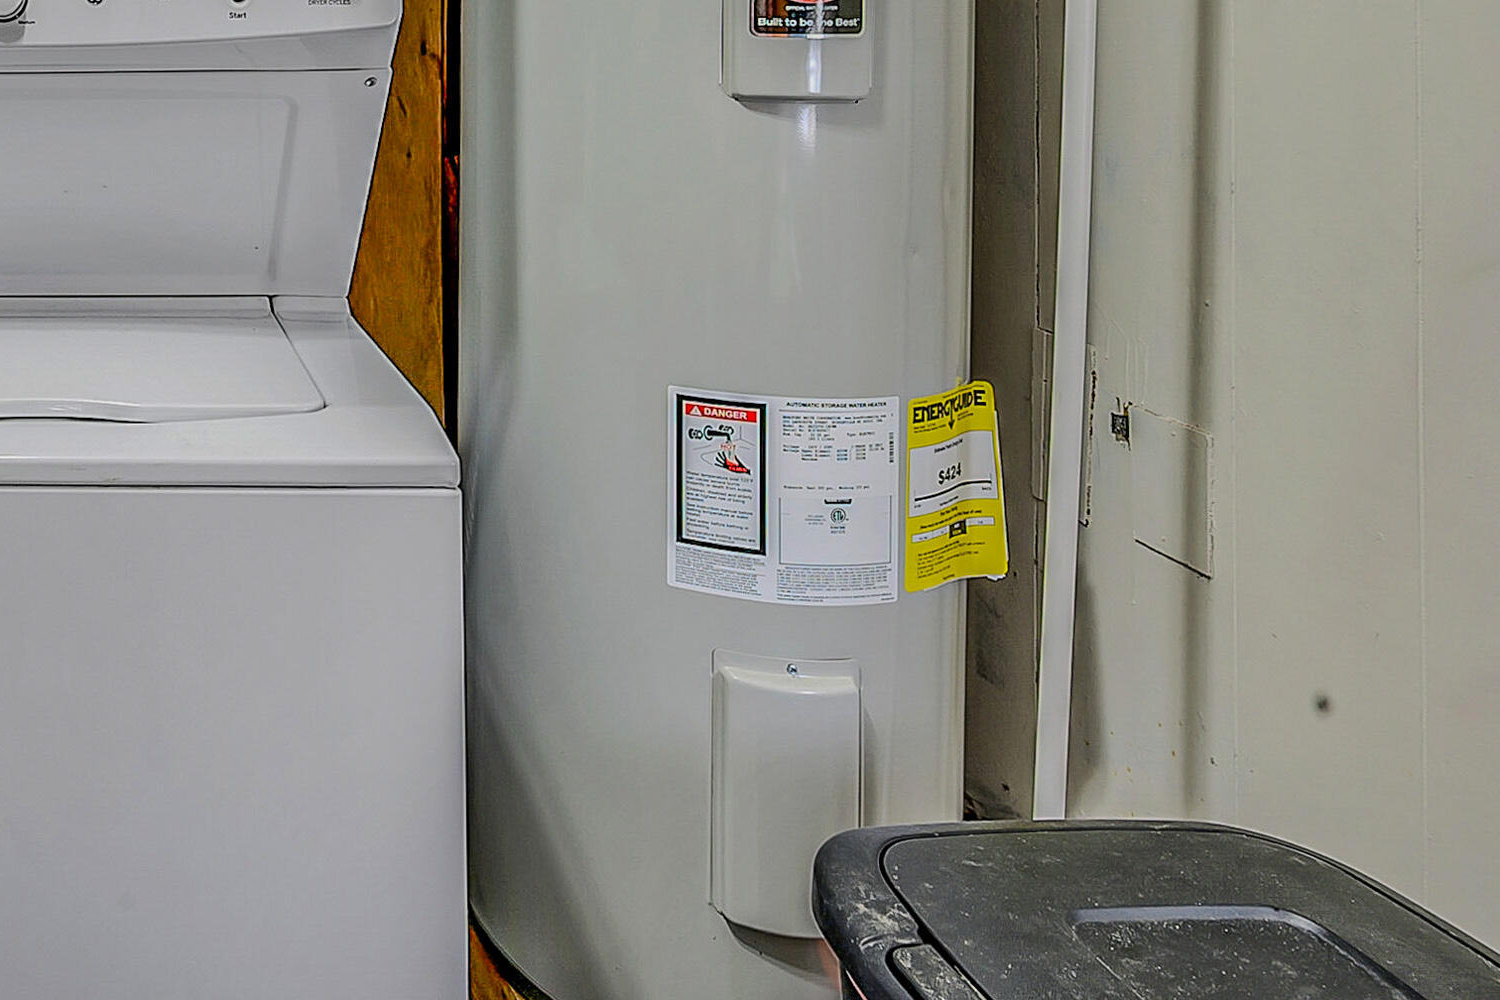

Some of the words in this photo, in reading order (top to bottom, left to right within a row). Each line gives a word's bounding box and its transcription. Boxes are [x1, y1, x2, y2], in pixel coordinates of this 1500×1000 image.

[757, 18, 784, 27] Built
[785, 18, 797, 27] to
[835, 18, 858, 27] Best
[912, 389, 987, 424] ENERGYGUIDE
[703, 407, 748, 420] DANGER
